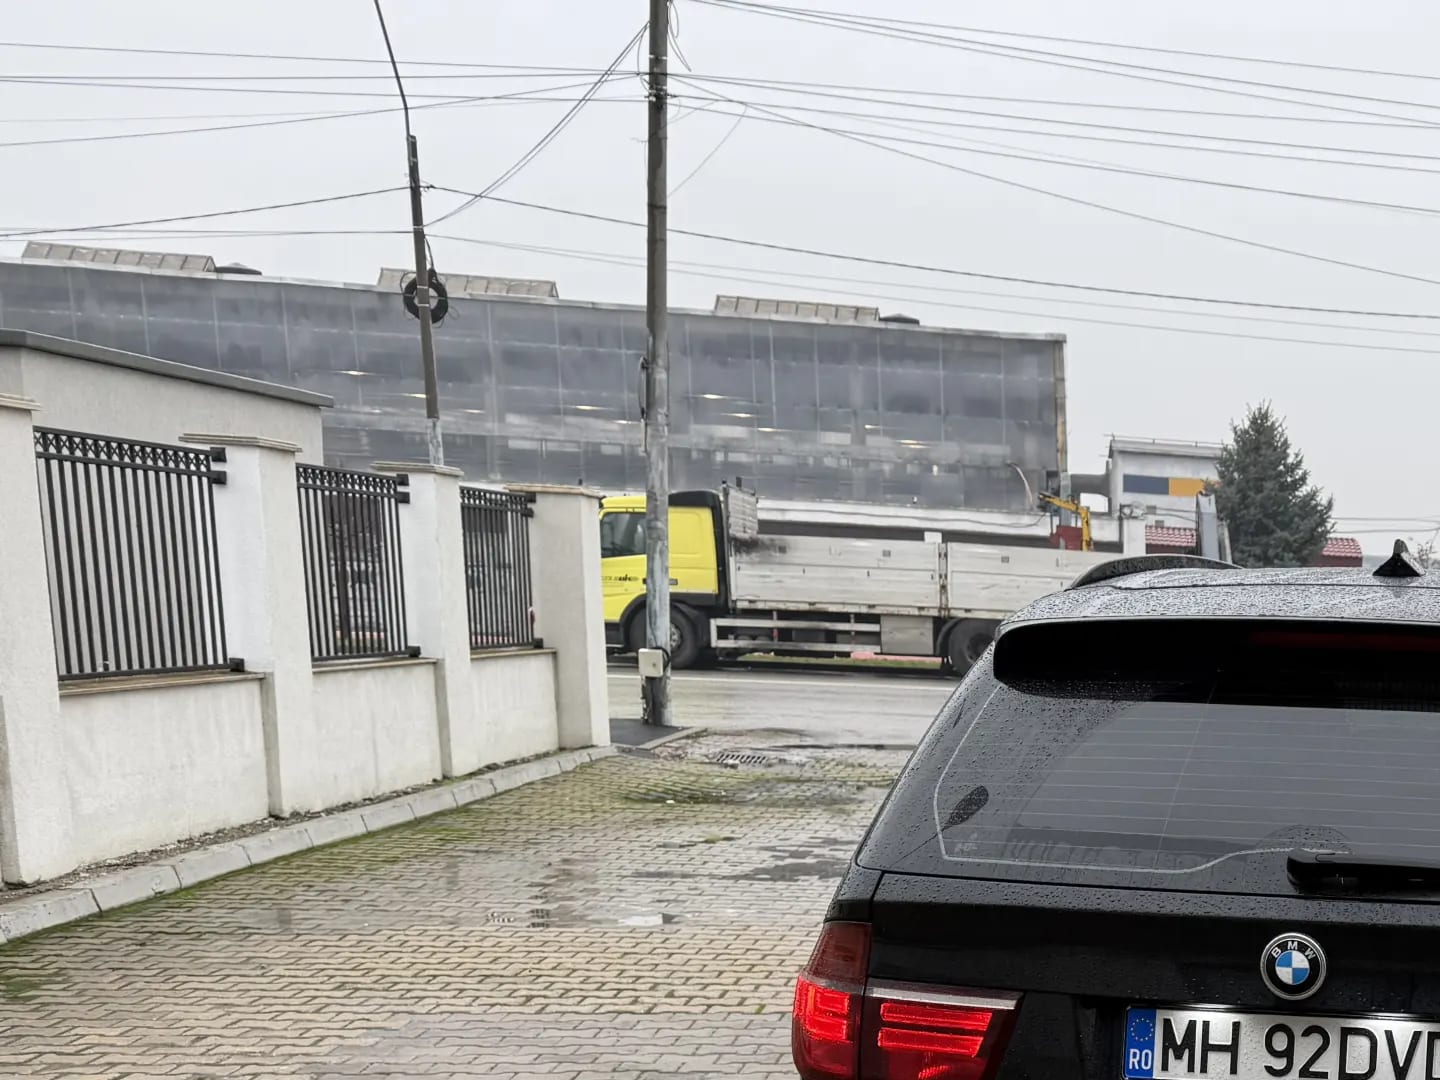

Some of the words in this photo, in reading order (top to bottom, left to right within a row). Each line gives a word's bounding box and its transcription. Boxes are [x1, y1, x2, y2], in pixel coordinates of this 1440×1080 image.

[1271, 941, 1316, 960] BMW
[1161, 1018, 1241, 1075] MH
[1129, 1049, 1152, 1070] RO
